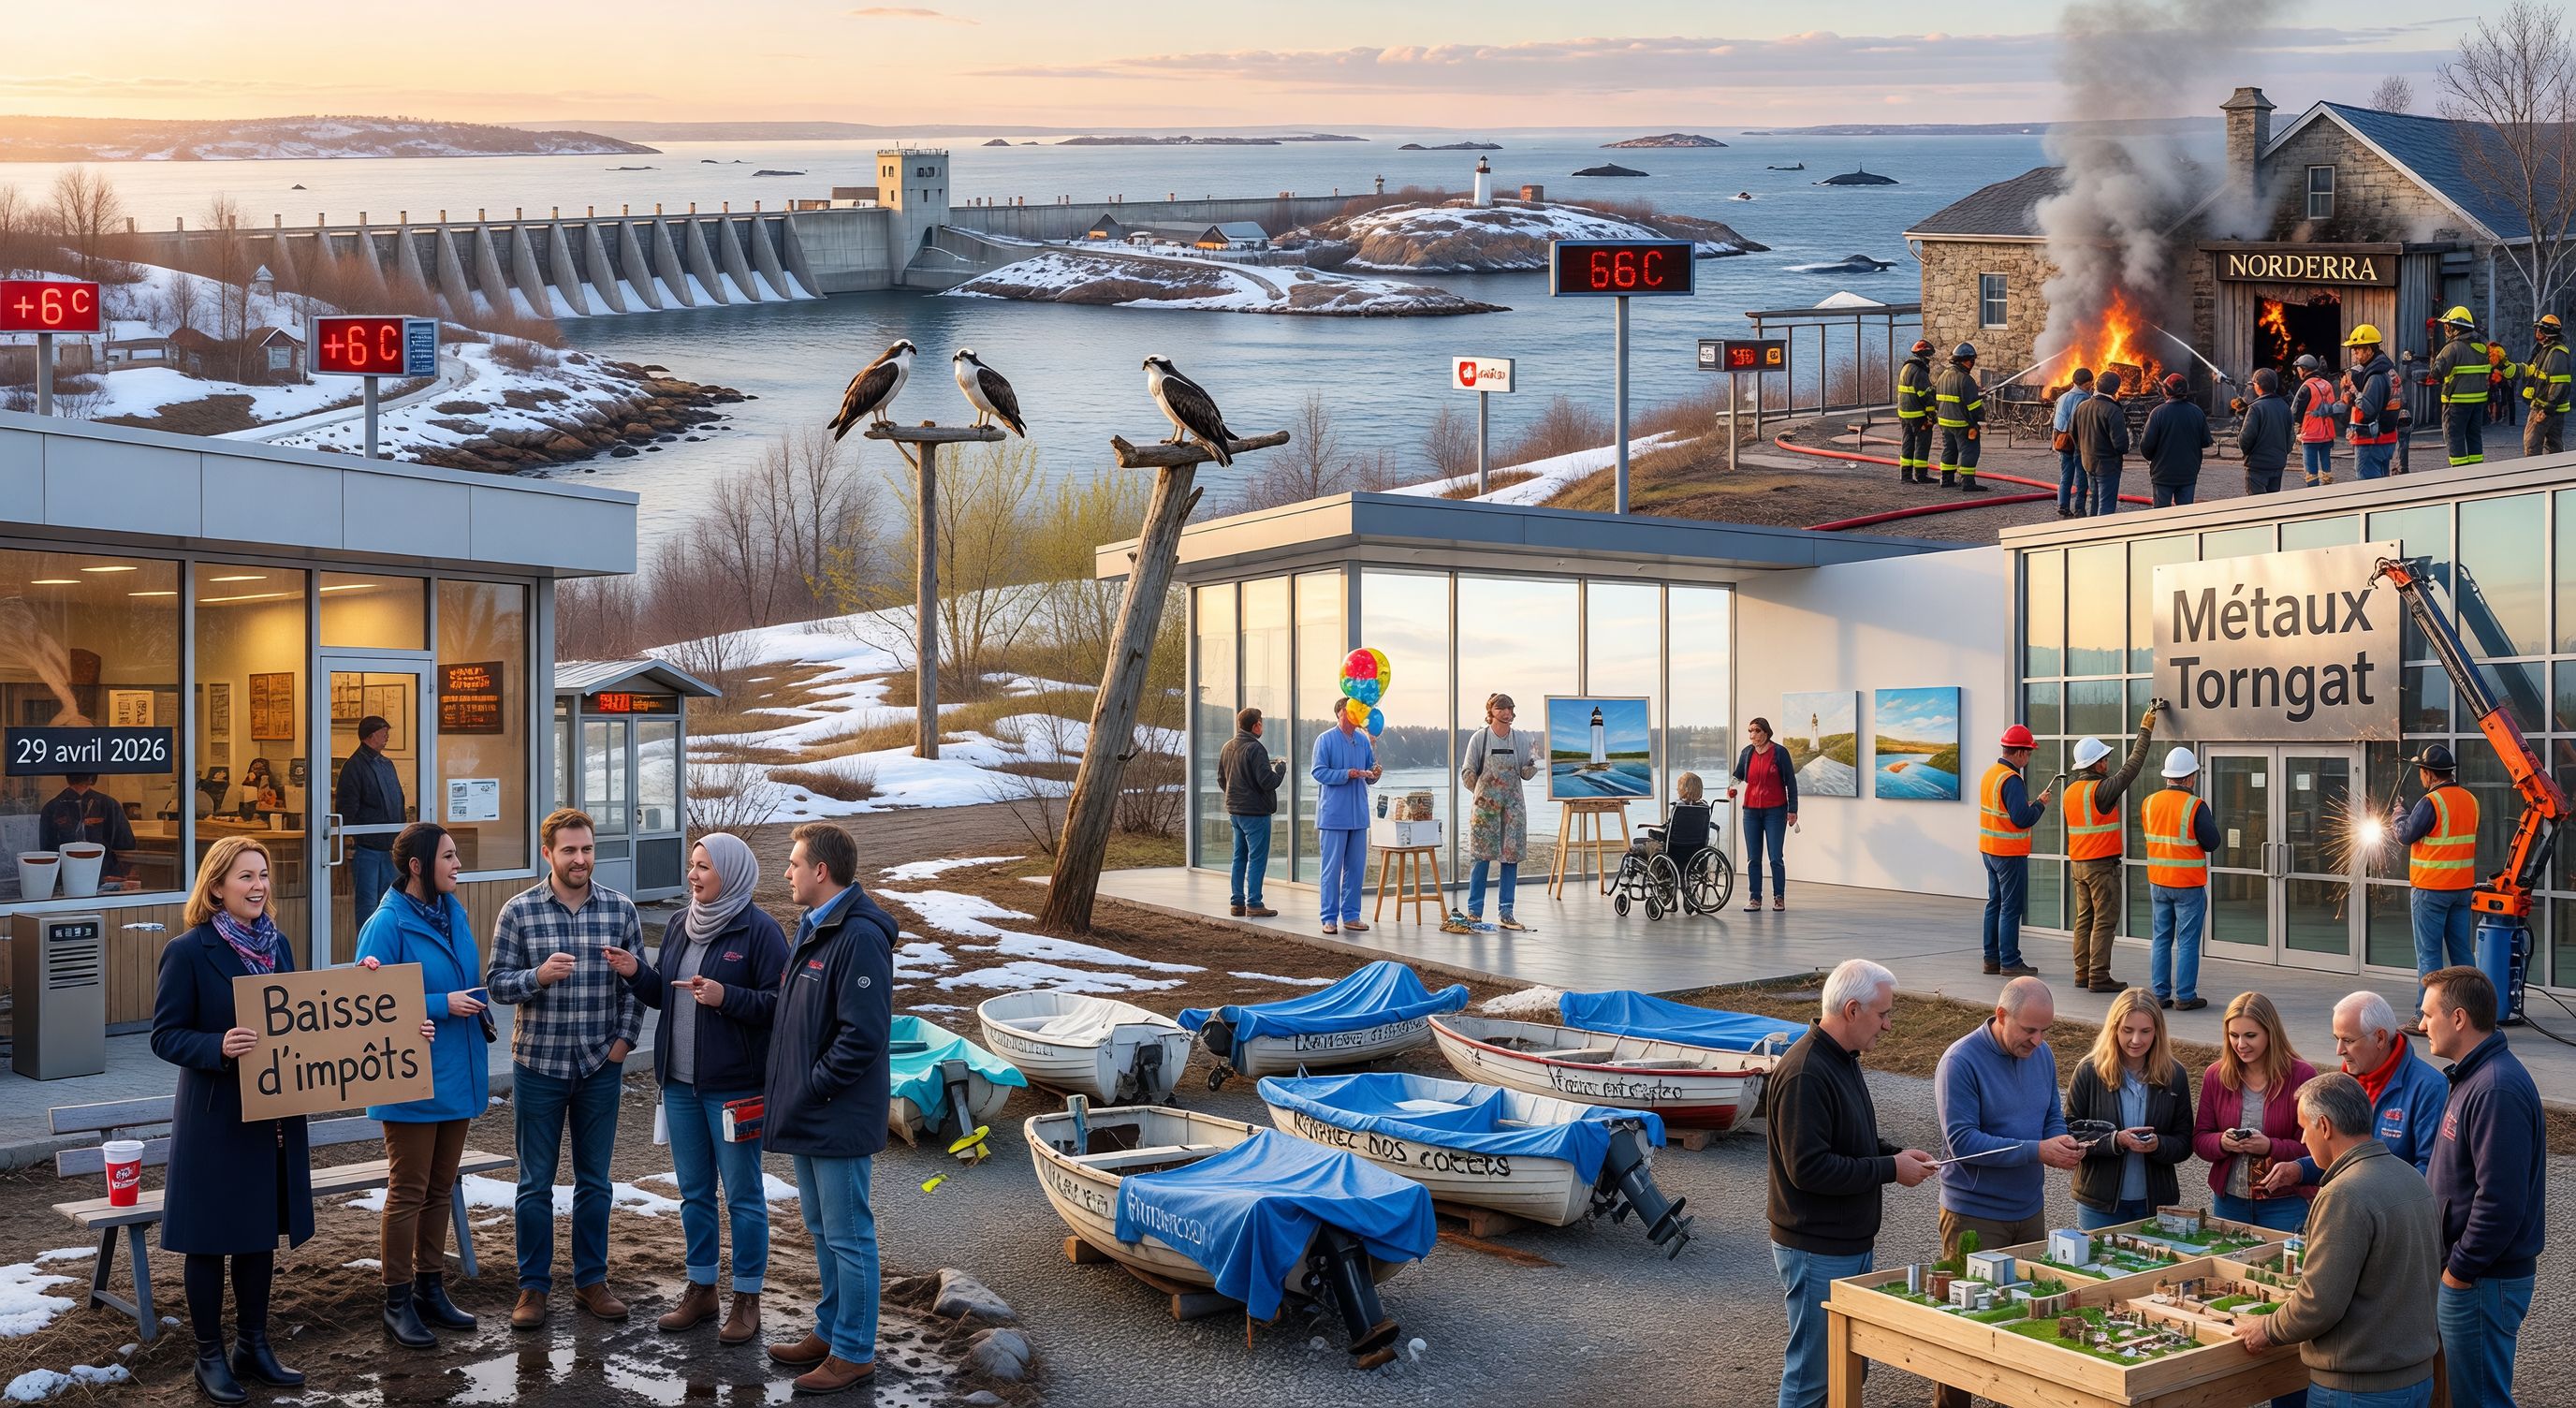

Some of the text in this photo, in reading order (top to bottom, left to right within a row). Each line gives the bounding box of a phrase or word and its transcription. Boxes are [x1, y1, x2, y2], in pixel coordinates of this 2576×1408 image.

[2229, 254, 2378, 281] NORDERRA
[2173, 582, 2374, 643] Métaux
[2169, 652, 2375, 723] Torngat
[16, 735, 167, 764] 29 avril 2026
[263, 985, 398, 1037] Baisse
[257, 1035, 419, 1102] d'impôts
